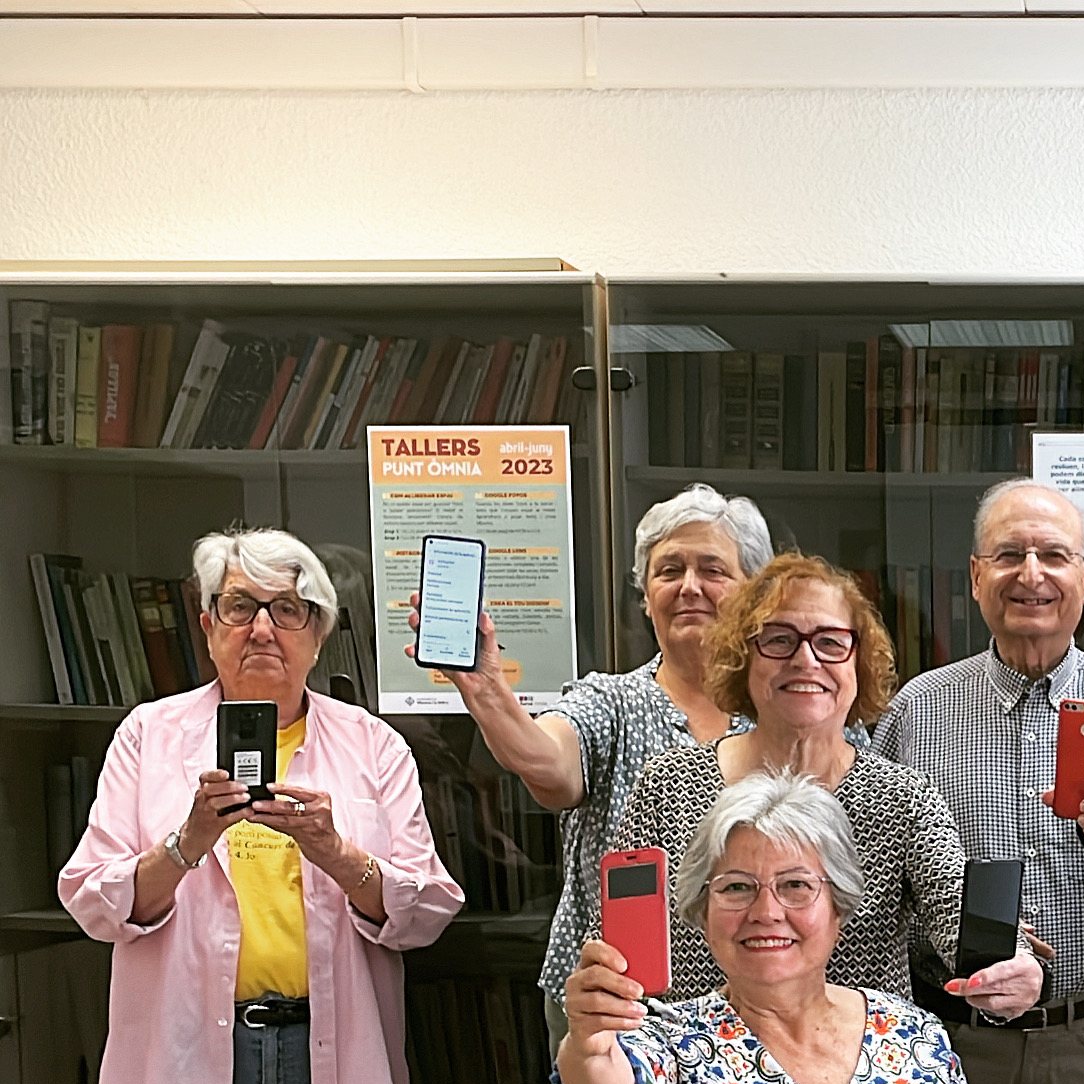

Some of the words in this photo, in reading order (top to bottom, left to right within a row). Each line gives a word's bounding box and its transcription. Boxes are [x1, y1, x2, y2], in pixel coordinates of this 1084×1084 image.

[381, 438, 481, 457] TALLERS
[499, 441, 553, 457] abril-juny
[382, 461, 424, 476] PUNT
[427, 457, 482, 476] ÒMNIA
[501, 458, 554, 475] 2023
